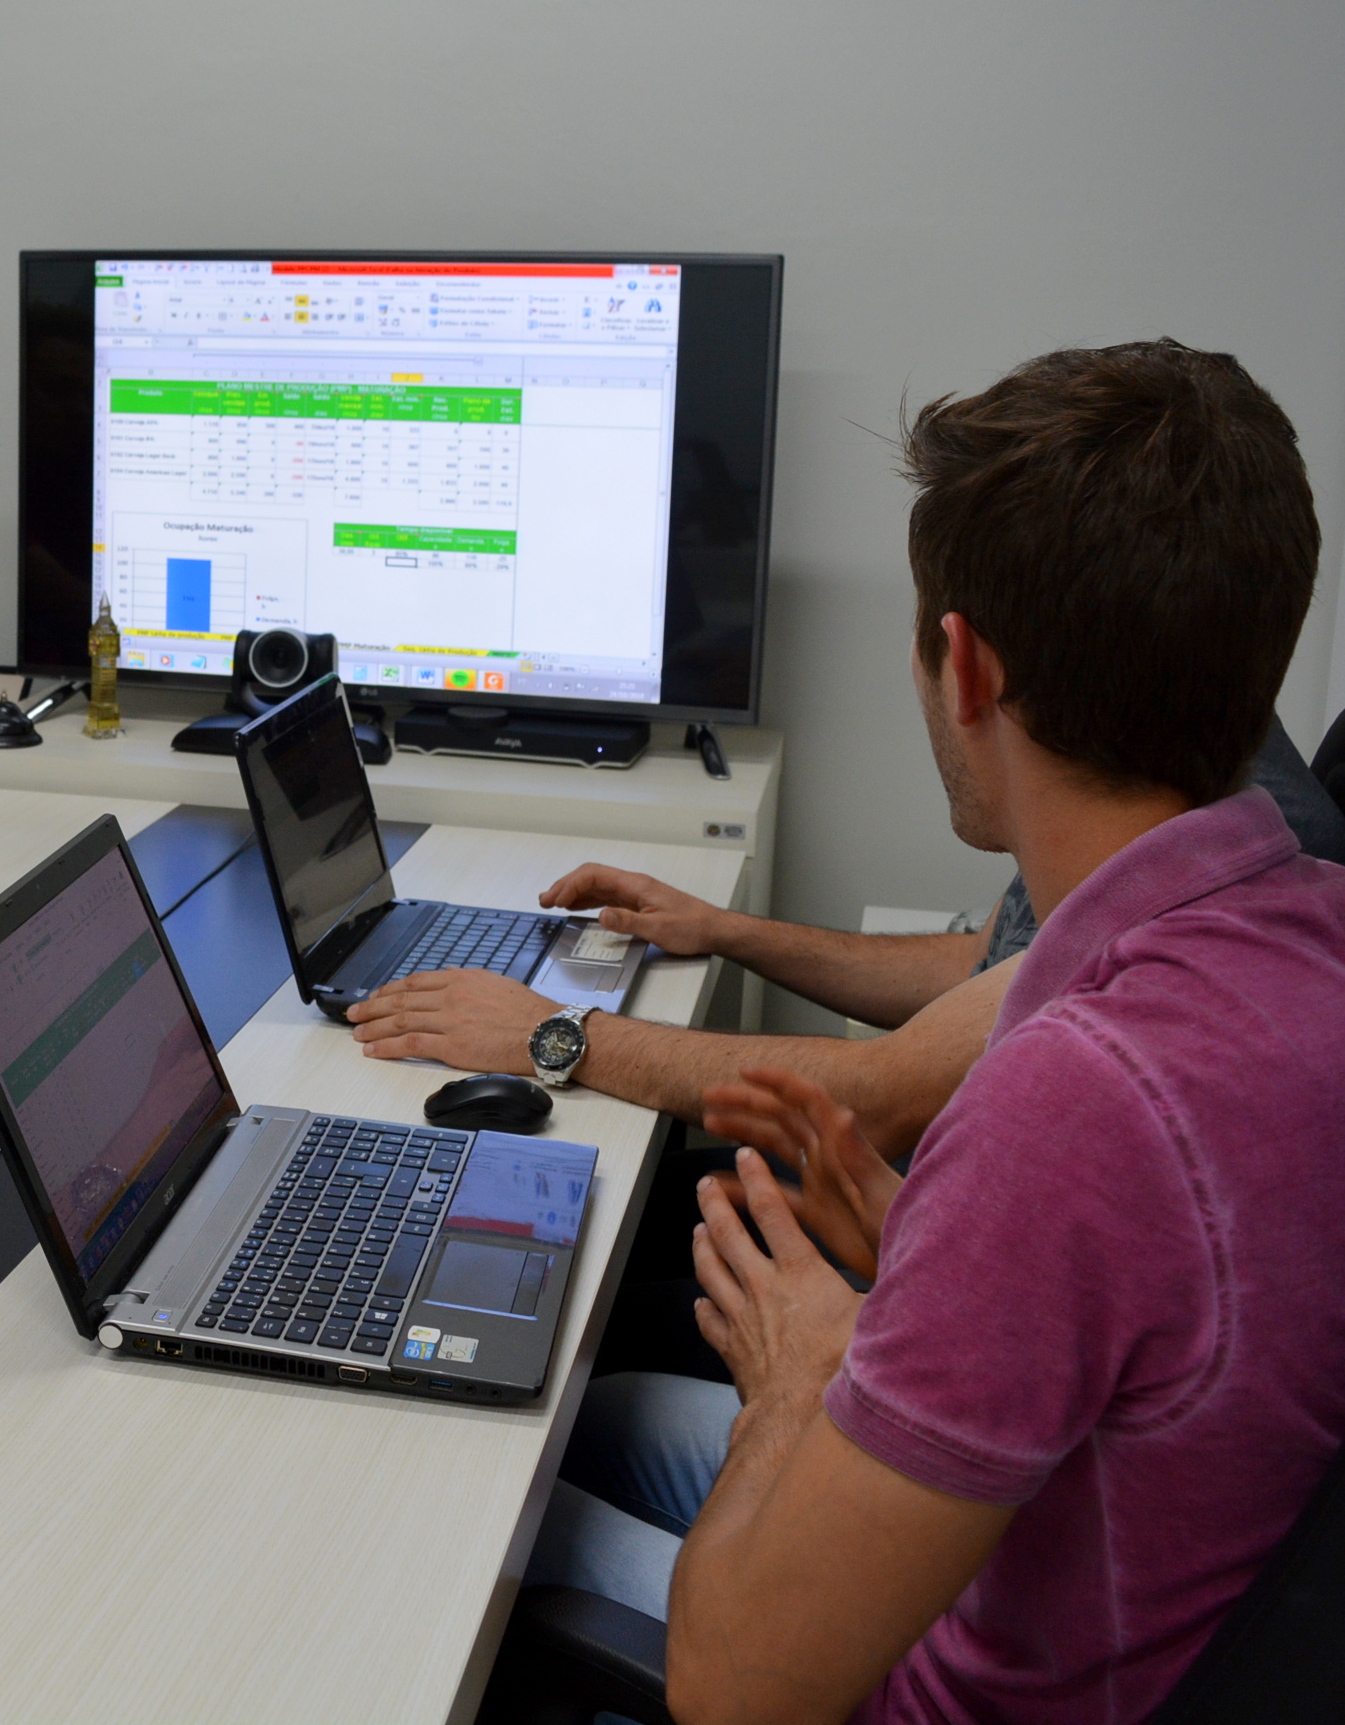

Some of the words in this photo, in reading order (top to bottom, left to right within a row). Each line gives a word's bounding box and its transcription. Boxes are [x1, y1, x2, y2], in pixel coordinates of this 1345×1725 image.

[163, 522, 205, 532] Ocupação
[207, 523, 254, 534] Maturação
[495, 736, 522, 748] AVAYA
